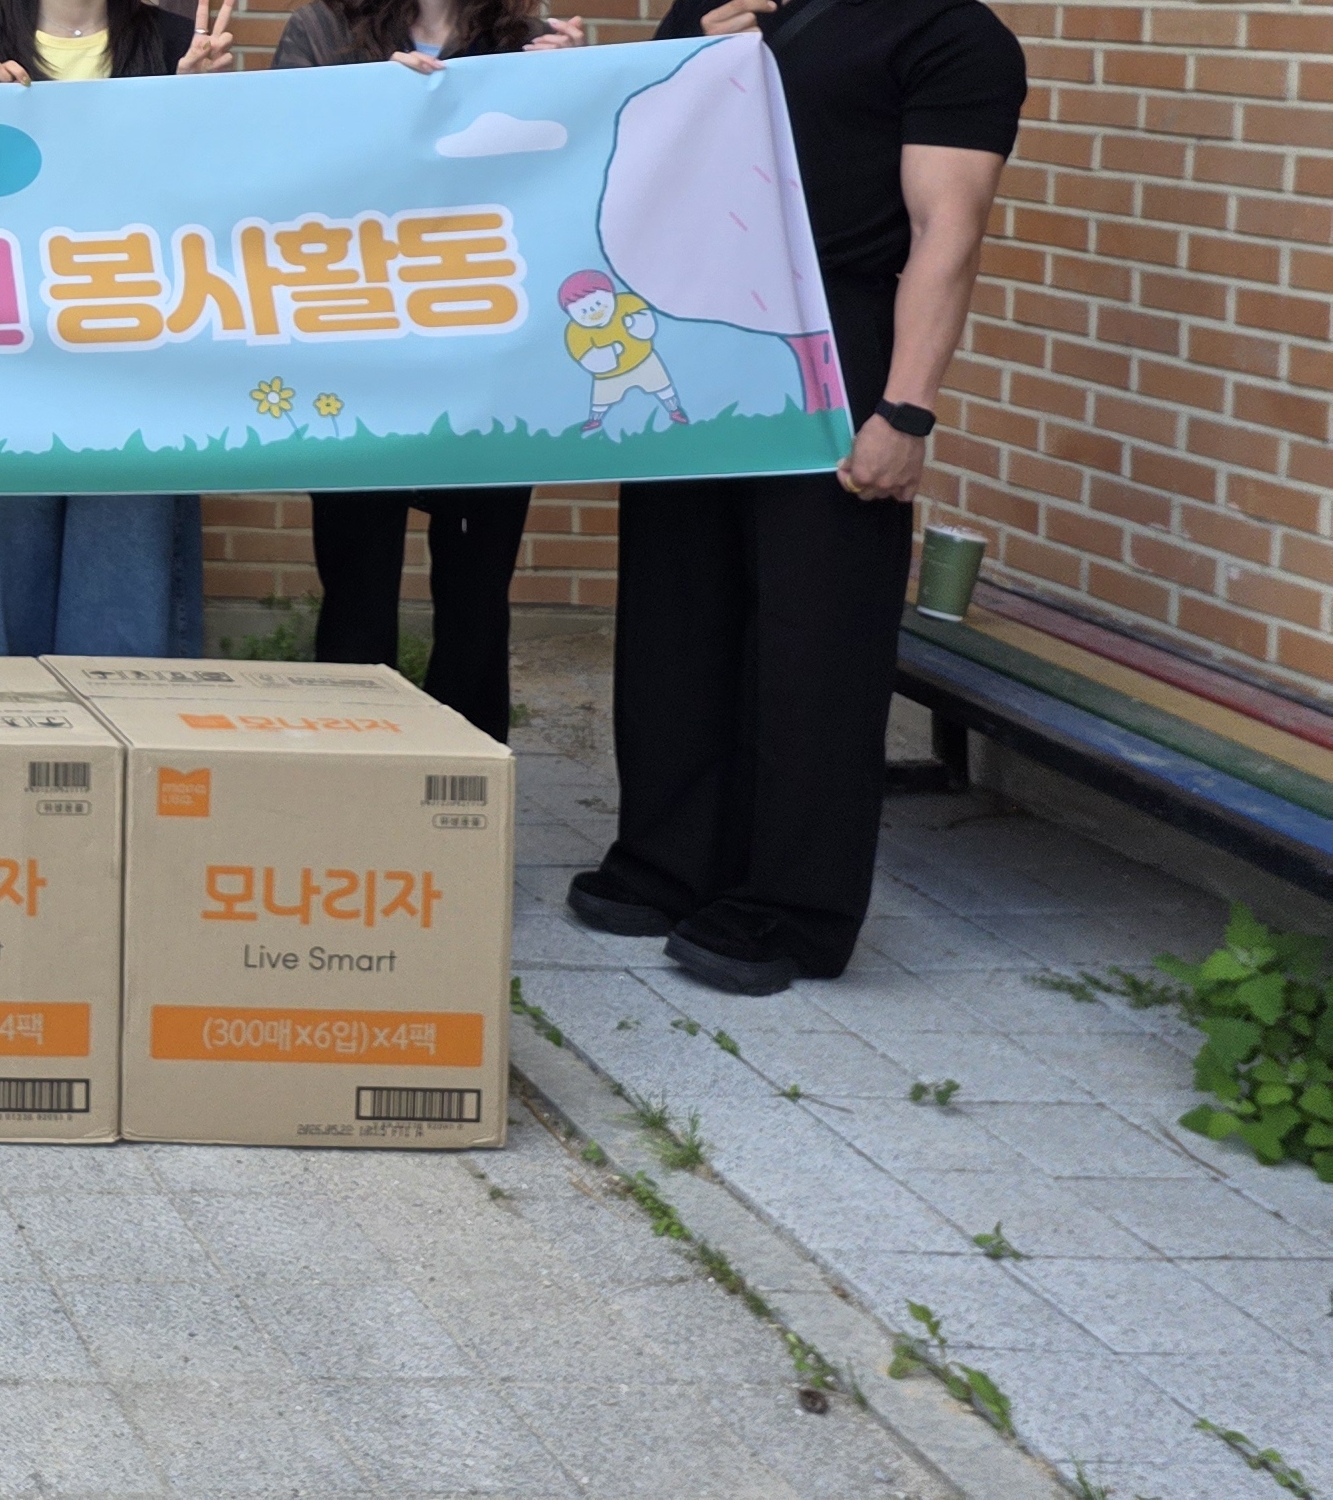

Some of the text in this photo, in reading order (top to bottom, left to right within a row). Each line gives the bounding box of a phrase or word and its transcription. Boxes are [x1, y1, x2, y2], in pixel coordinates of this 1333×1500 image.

[44, 209, 522, 347] 봉사활동
[200, 864, 445, 929] 모나리자
[243, 943, 397, 973] Live Smart
